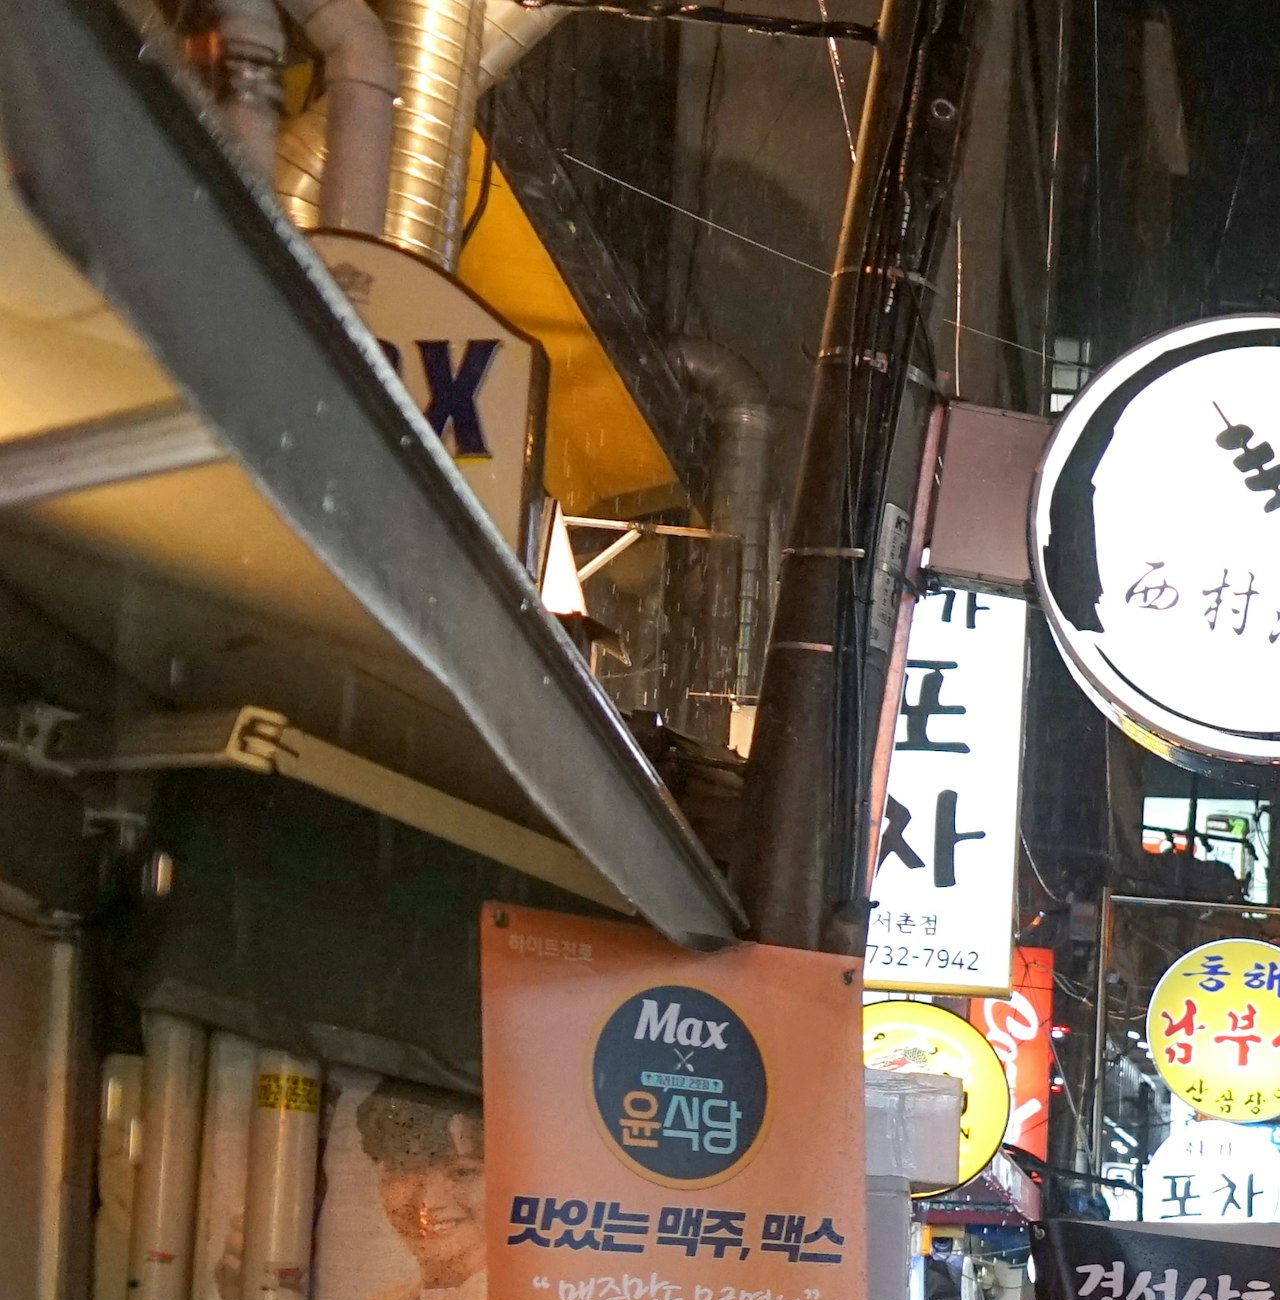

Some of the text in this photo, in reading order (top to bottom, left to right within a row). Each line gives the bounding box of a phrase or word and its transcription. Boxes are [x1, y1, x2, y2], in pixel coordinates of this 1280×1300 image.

[508, 932, 593, 962] 하이트진로
[871, 913, 938, 936] 서촌점
[865, 944, 980, 972] 732-7942
[634, 998, 731, 1051] Max
[618, 1087, 743, 1156] 윤식당
[1160, 1172, 1265, 1221] 포차
[506, 1195, 846, 1265] 맛있는 맥주, 맥스
